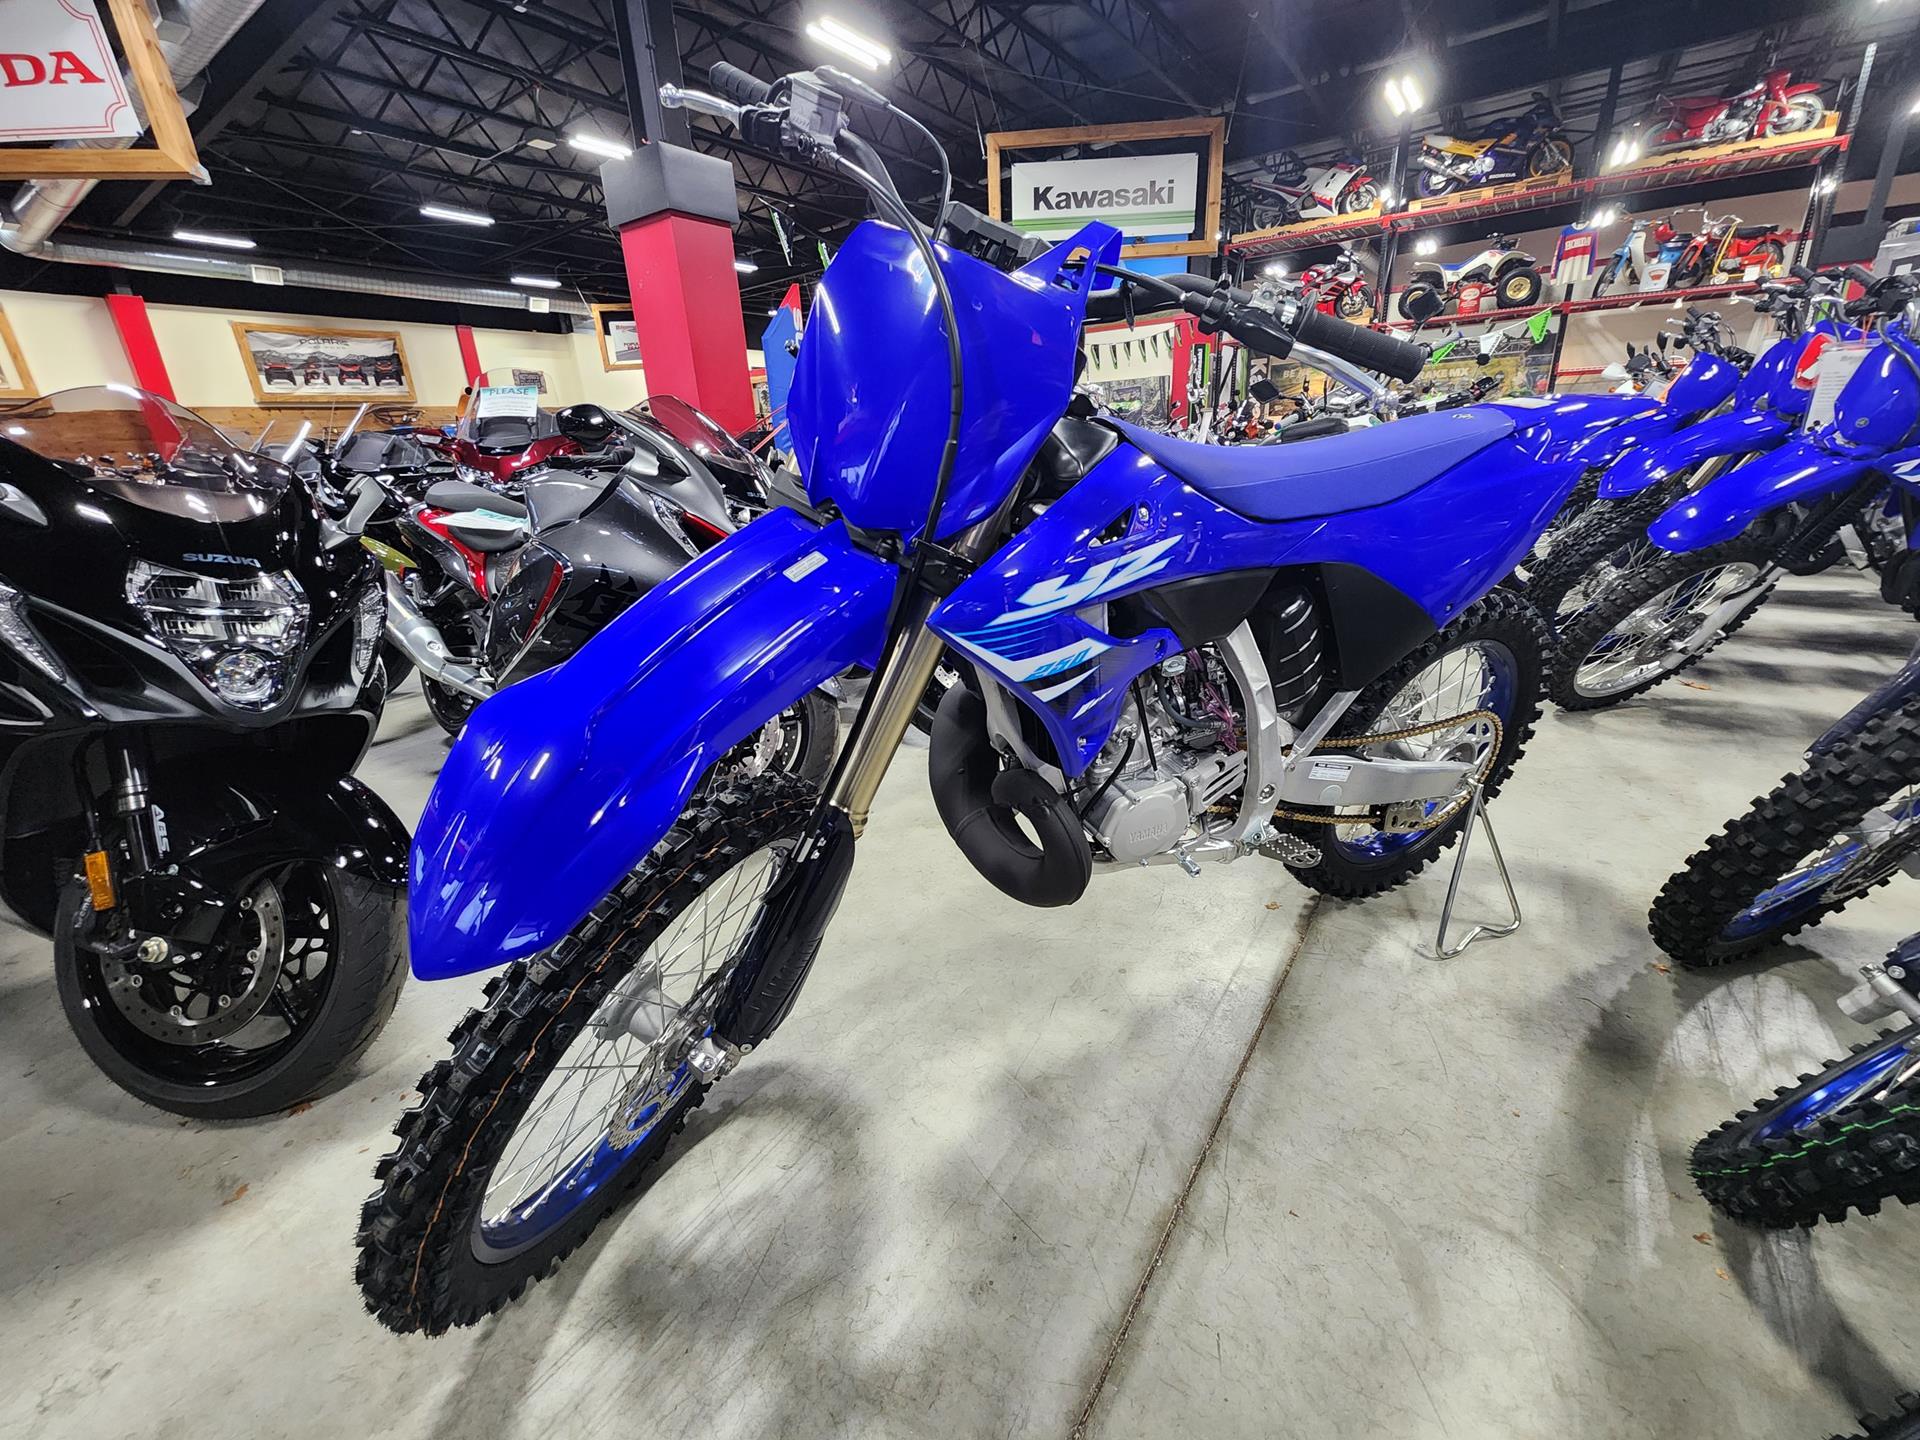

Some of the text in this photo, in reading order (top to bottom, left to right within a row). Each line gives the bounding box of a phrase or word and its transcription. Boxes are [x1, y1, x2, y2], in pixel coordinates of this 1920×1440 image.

[1033, 179, 1175, 211] Kawasaki
[299, 336, 350, 347] POLARIS
[490, 387, 529, 396] PLEASE
[182, 553, 261, 568] SUZUKI
[998, 534, 1184, 618] YZ
[1023, 647, 1093, 682] 250
[151, 804, 170, 852] ABS
